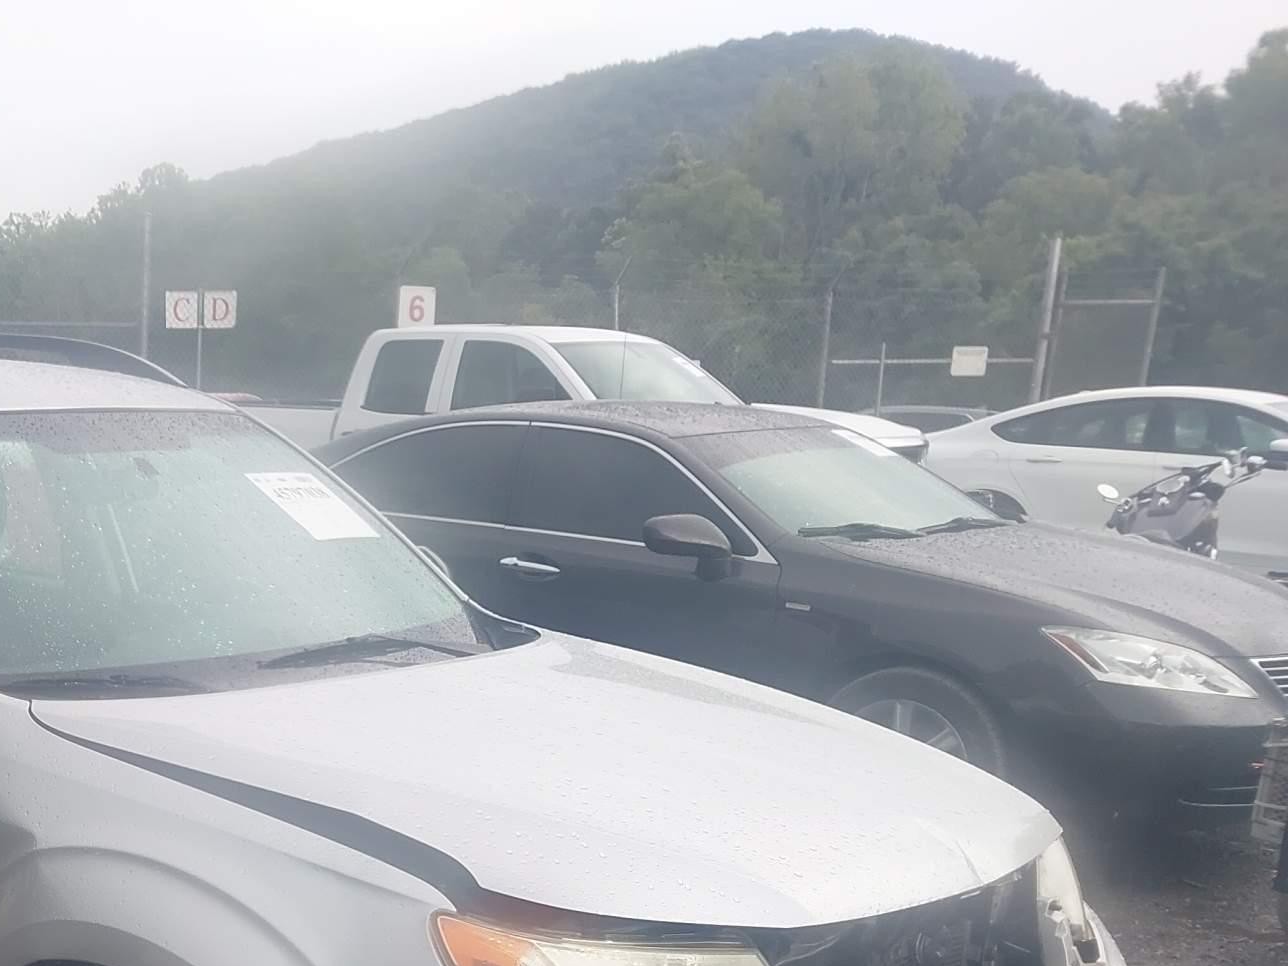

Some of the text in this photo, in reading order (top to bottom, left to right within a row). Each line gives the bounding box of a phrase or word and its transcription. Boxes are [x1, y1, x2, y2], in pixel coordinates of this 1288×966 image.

[173, 297, 191, 322] C
[212, 297, 230, 321] D
[409, 295, 425, 322] 6
